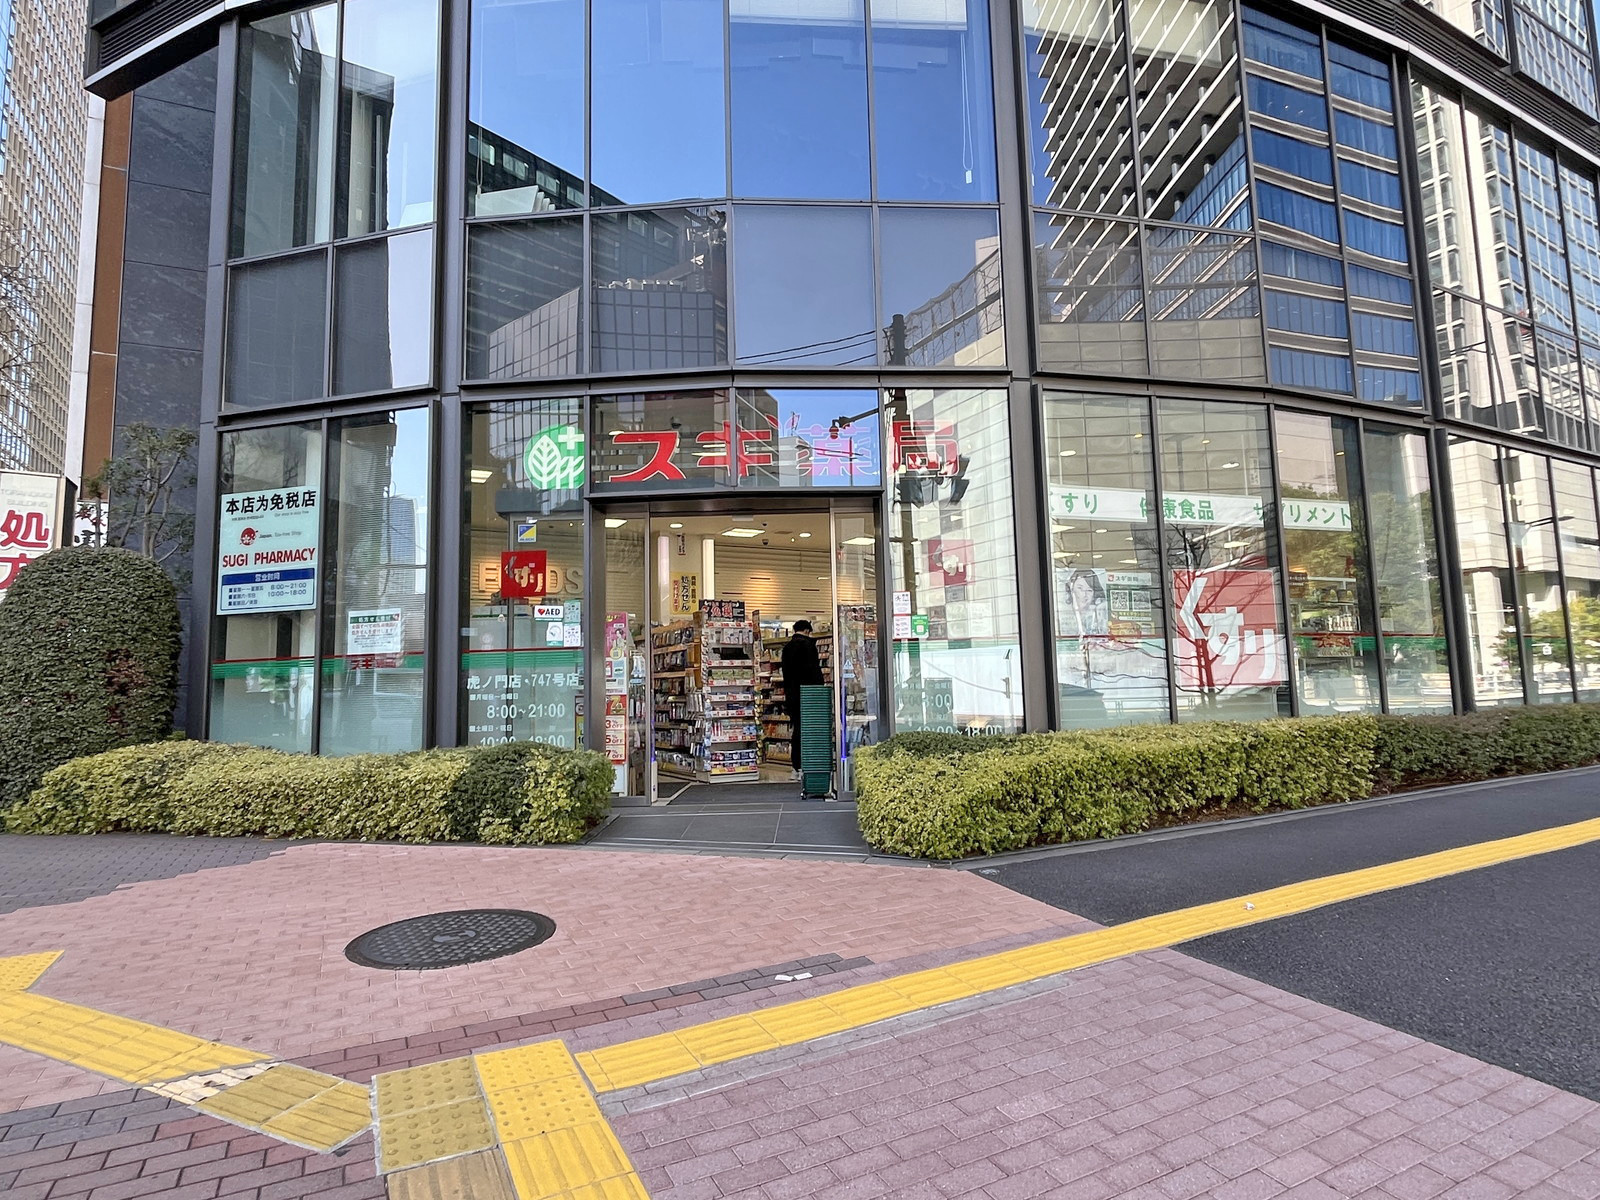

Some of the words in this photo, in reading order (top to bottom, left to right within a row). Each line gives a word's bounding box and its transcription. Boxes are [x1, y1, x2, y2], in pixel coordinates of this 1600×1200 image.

[225, 490, 316, 515] 本店为免税店
[1253, 502, 1351, 527] サリメント
[222, 553, 249, 568] SUGI
[254, 547, 316, 565] PHARMACY
[478, 561, 584, 595] FDS
[545, 608, 561, 616] AED
[1179, 577, 1275, 681] くすり
